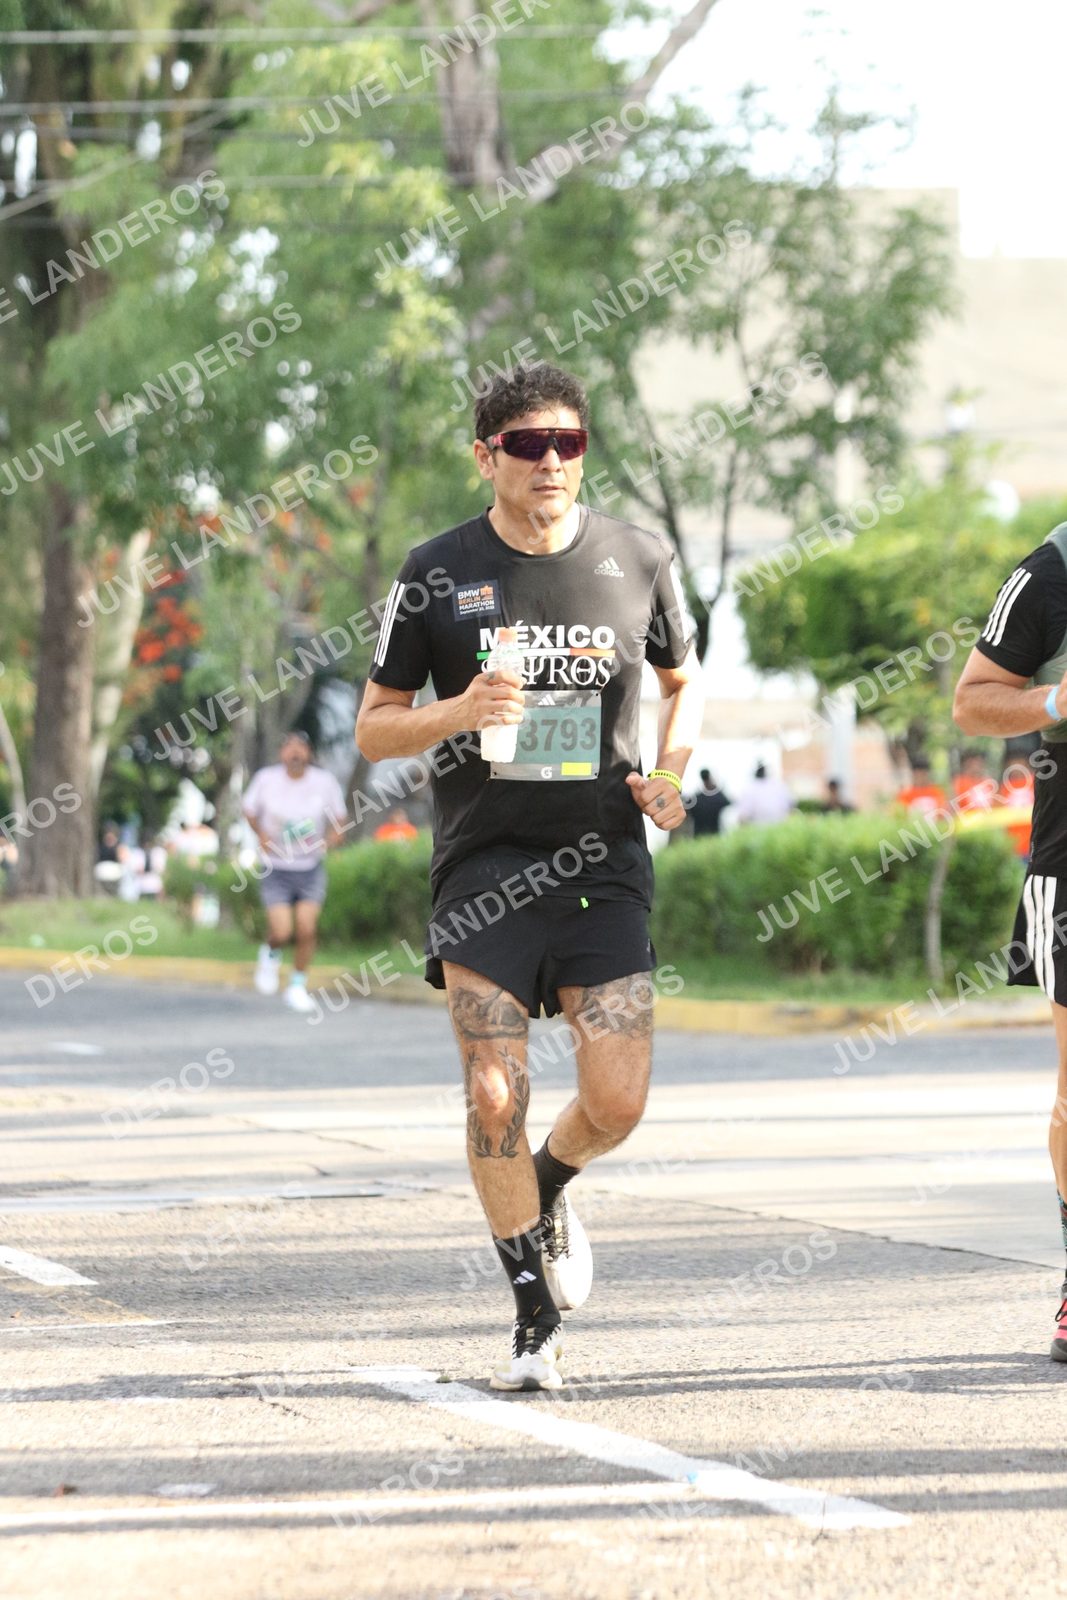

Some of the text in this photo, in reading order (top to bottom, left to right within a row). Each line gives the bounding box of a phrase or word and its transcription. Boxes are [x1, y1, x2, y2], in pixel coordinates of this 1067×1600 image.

[594, 567, 624, 578] adidas
[457, 588, 480, 600] BMW
[458, 596, 481, 605] BERLIN
[459, 600, 495, 610] MARATHON
[479, 620, 616, 650] MÉXICO
